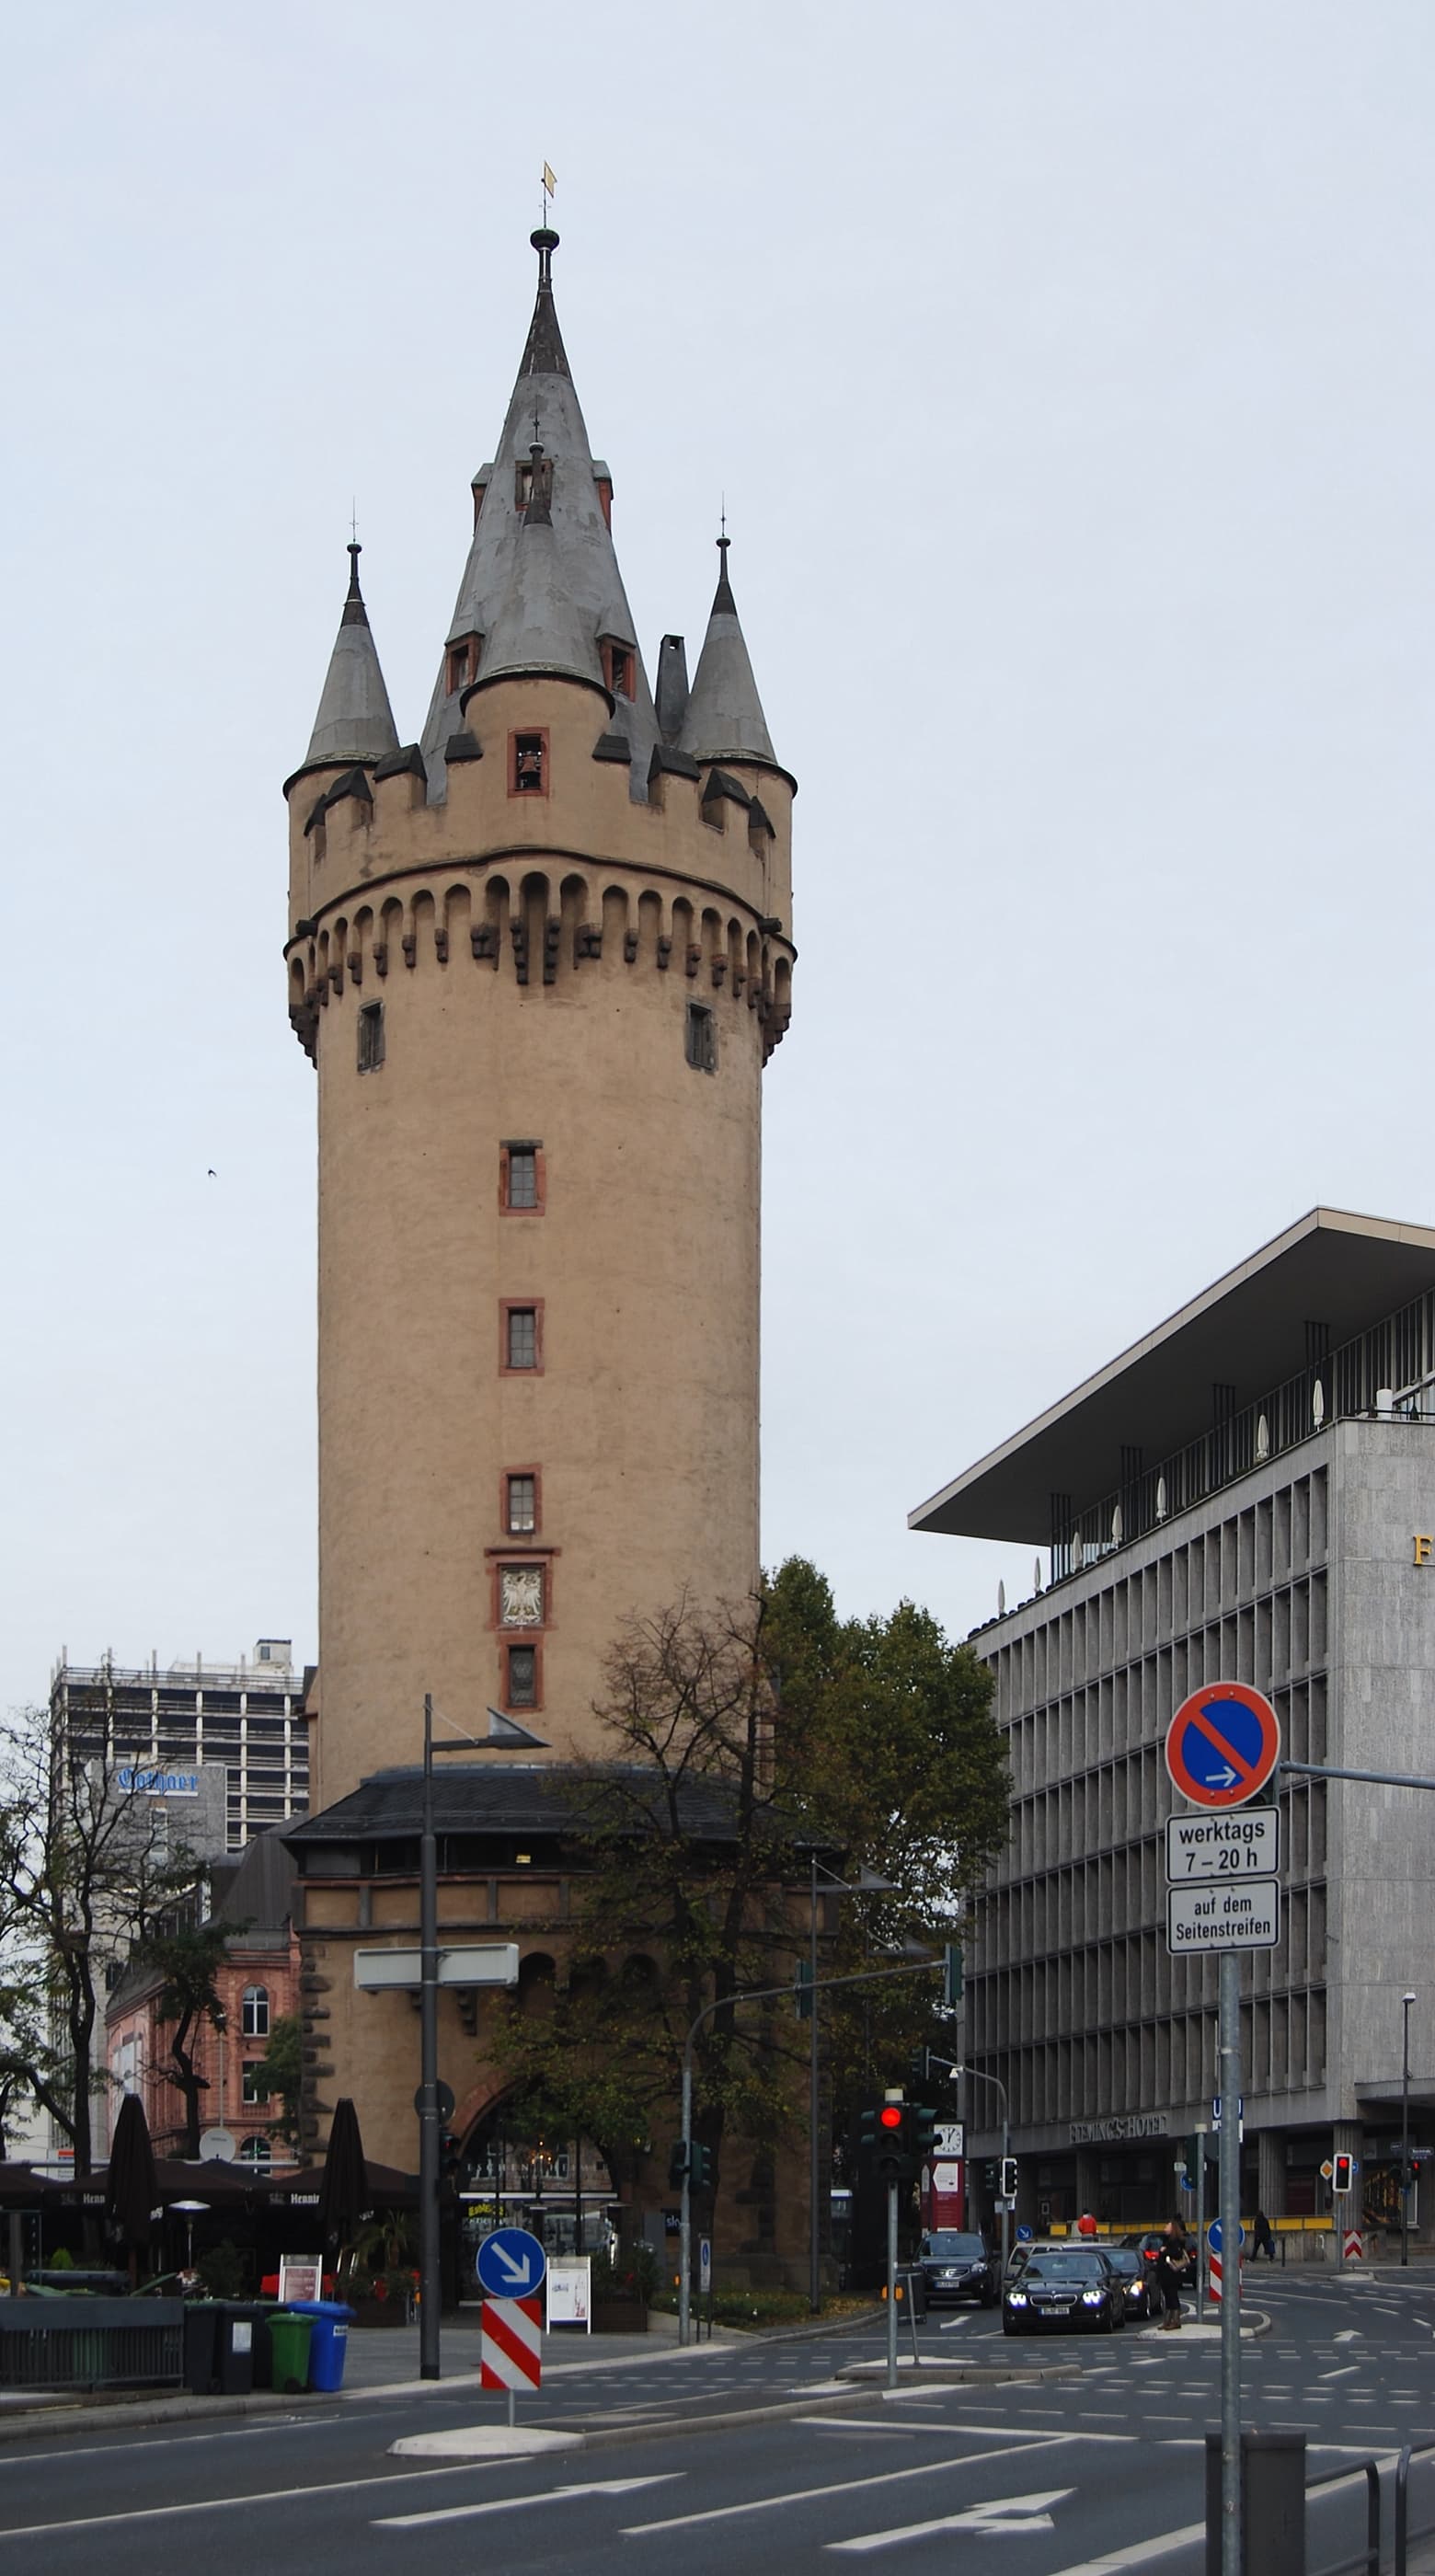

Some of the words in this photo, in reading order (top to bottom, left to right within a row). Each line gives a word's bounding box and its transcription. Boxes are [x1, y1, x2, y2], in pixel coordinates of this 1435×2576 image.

[1179, 1822, 1265, 1844] werktags
[1186, 1852, 1196, 1872] 7
[1219, 1848, 1240, 1869] 20
[1246, 1847, 1257, 1867] h
[1195, 1897, 1216, 1915] auf
[1223, 1896, 1252, 1913] dem
[1177, 1917, 1270, 1940] Seitenstreifen
[1127, 2113, 1168, 2137] HOTEL
[83, 2193, 106, 2204] Henn
